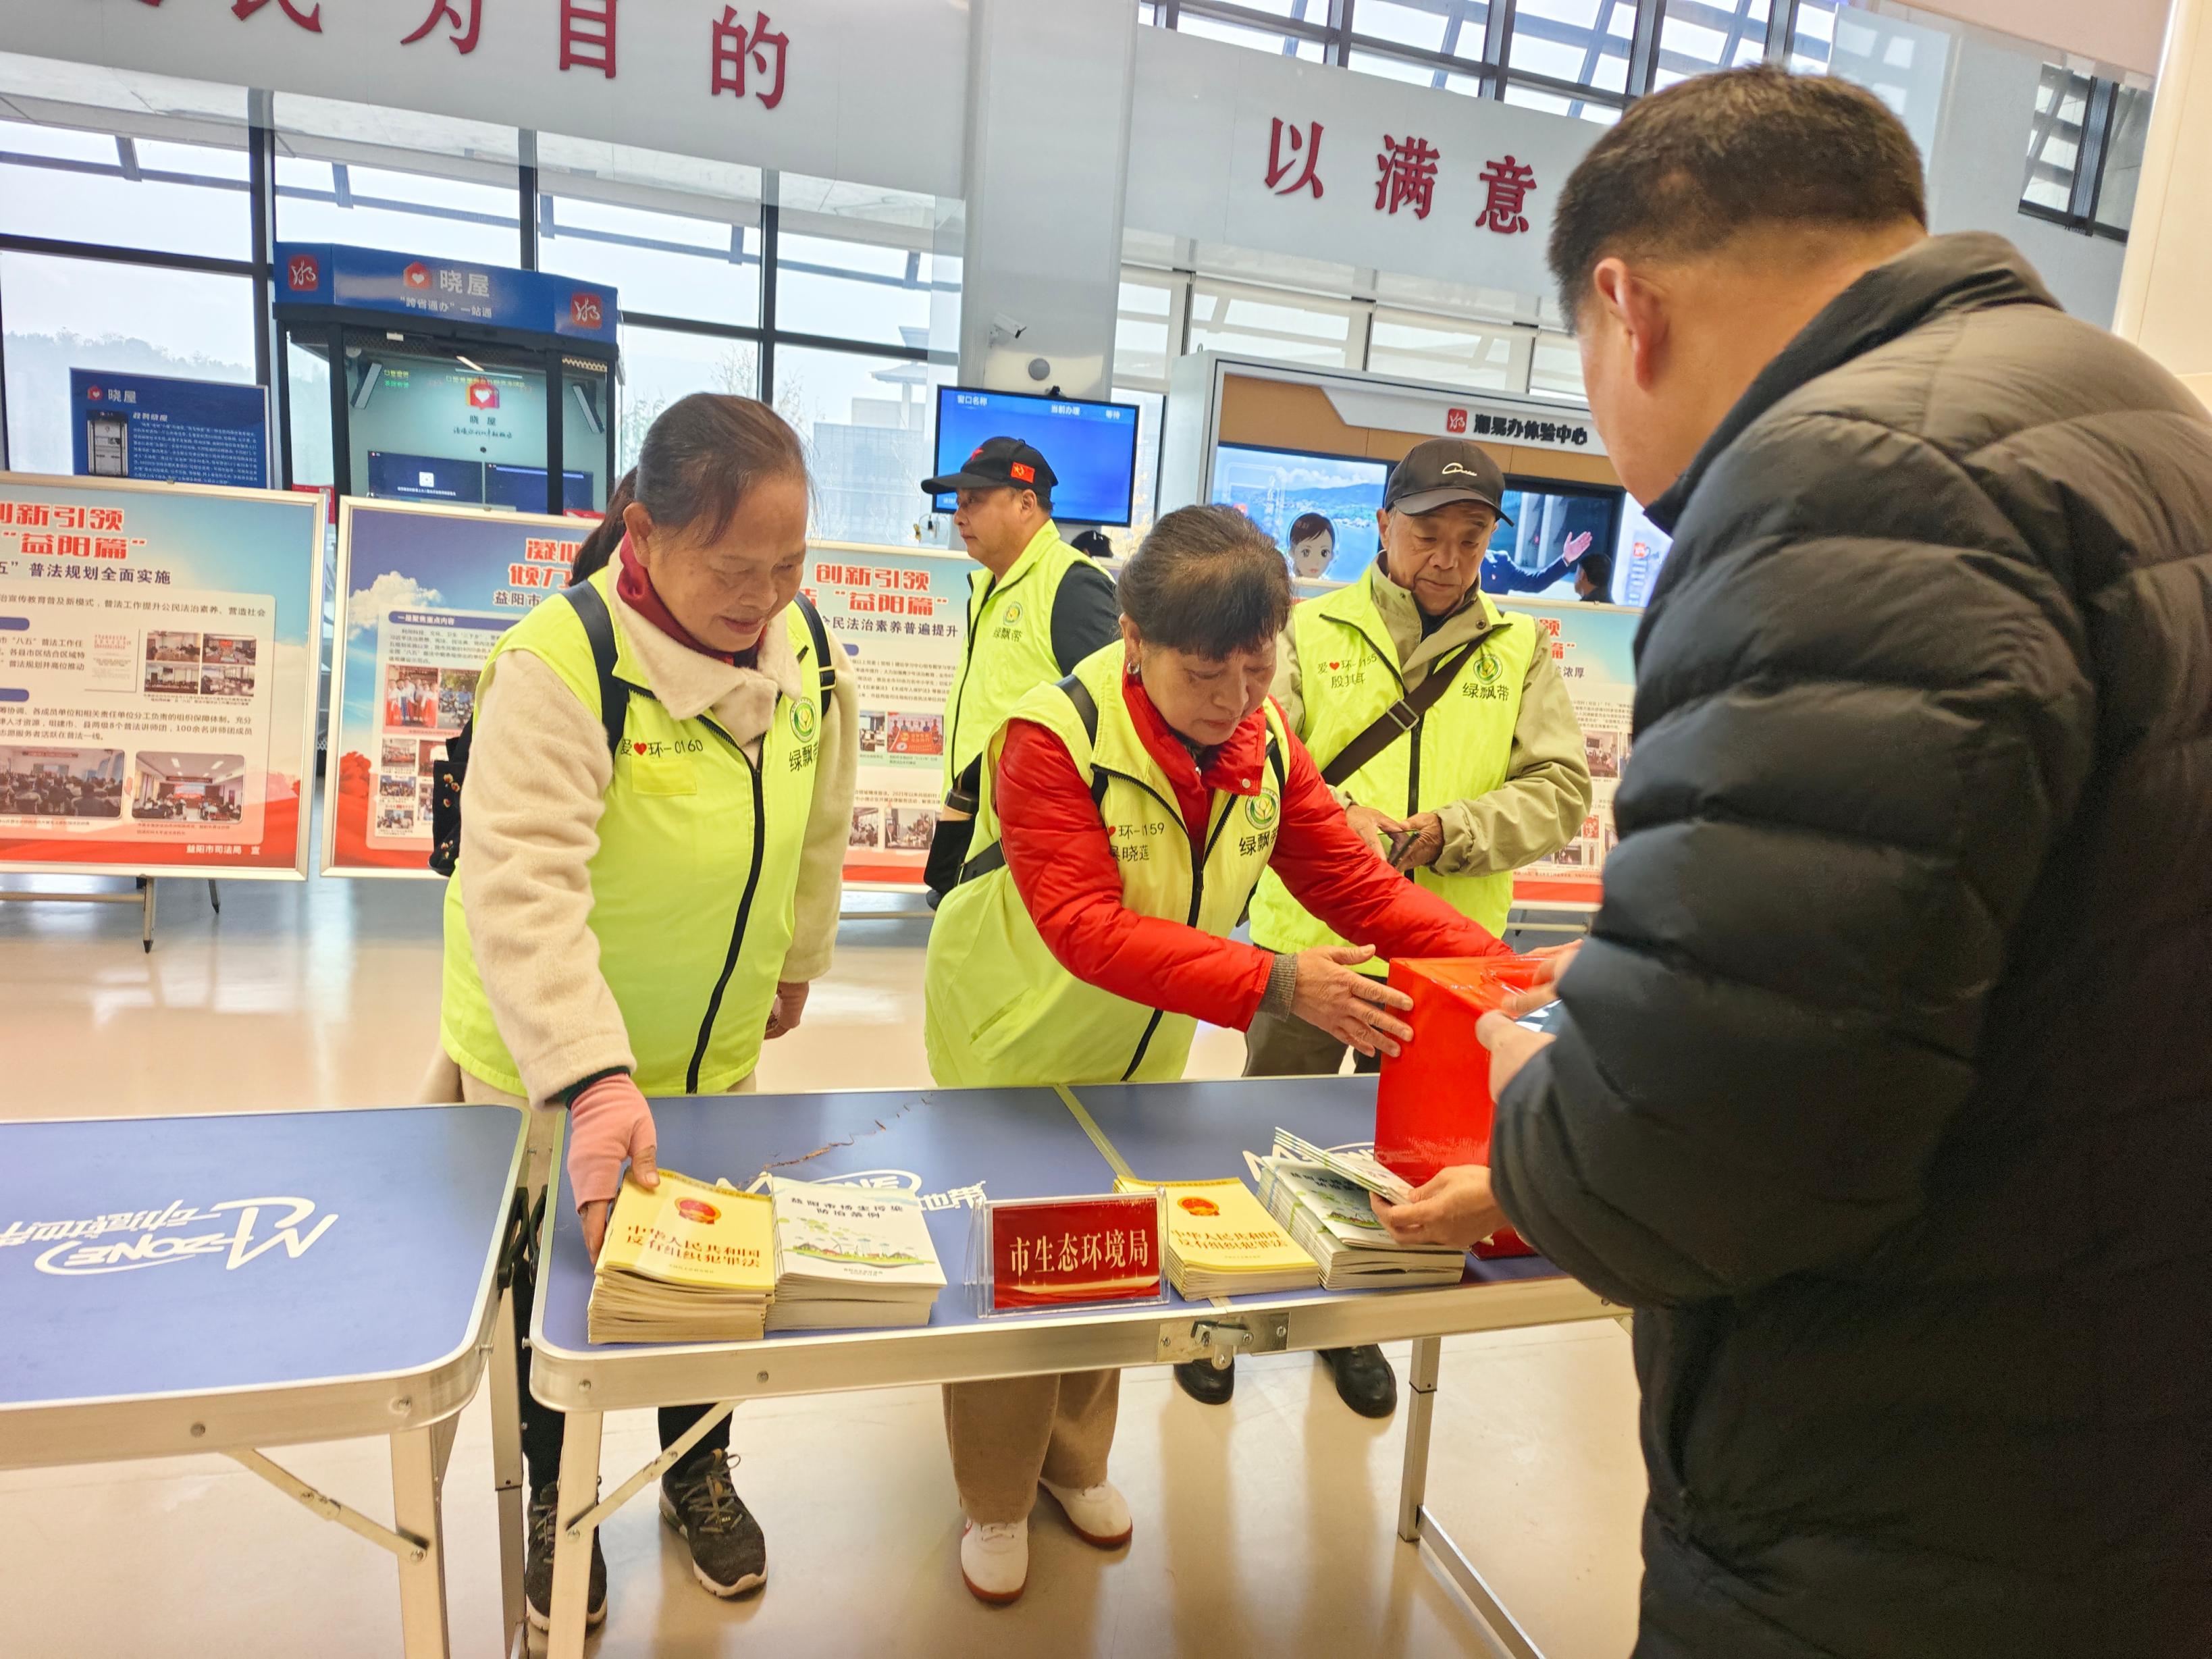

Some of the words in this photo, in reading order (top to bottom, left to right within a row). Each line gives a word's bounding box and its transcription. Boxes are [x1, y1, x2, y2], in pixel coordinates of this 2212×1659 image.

[1264, 117, 1537, 234] 以满意
[440, 270, 490, 298] 晓屋
[108, 389, 137, 404] 晓屋
[816, 564, 930, 591] 创新引领
[1463, 683, 1509, 701] 绿飘带
[1009, 1229, 1149, 1277] 市生态环境局
